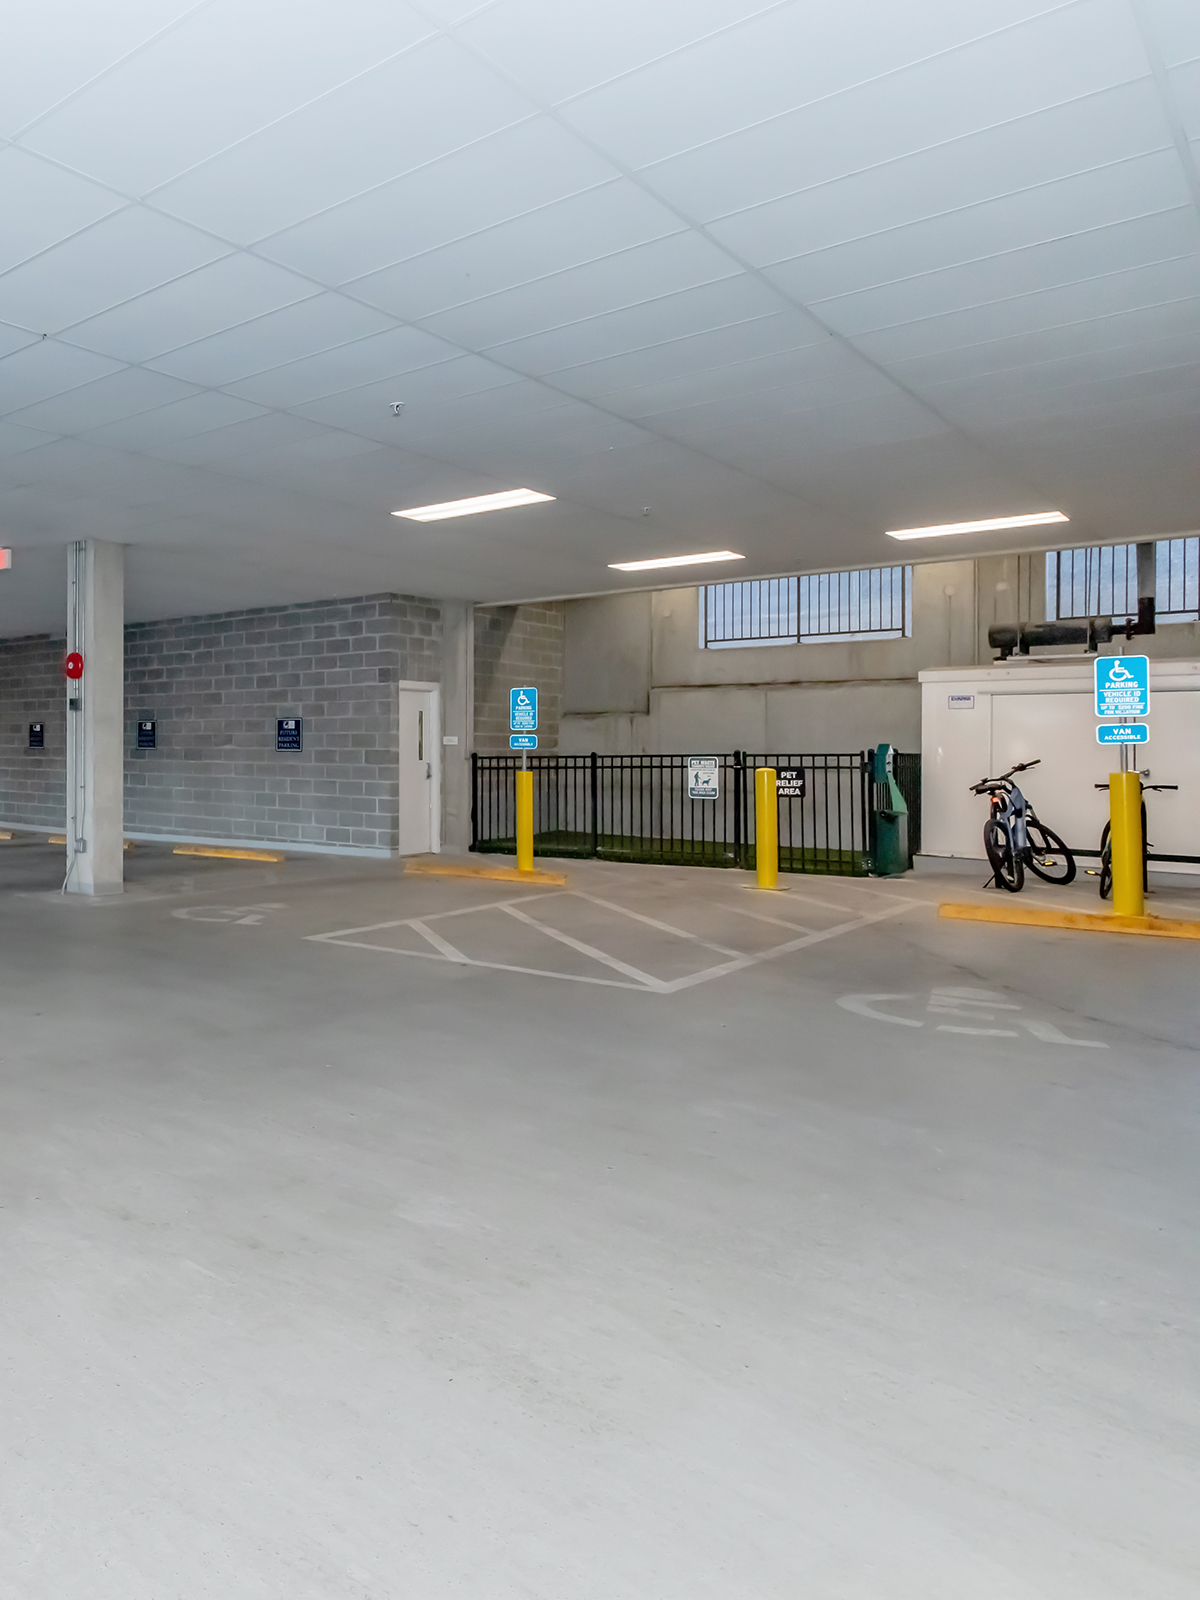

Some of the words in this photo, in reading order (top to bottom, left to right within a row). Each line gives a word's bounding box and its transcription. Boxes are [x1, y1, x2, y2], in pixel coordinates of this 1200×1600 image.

[1105, 681, 1139, 689] PARKING
[780, 771, 798, 779] PET
[775, 779, 803, 787] RELIEF
[778, 787, 801, 795] AREA
